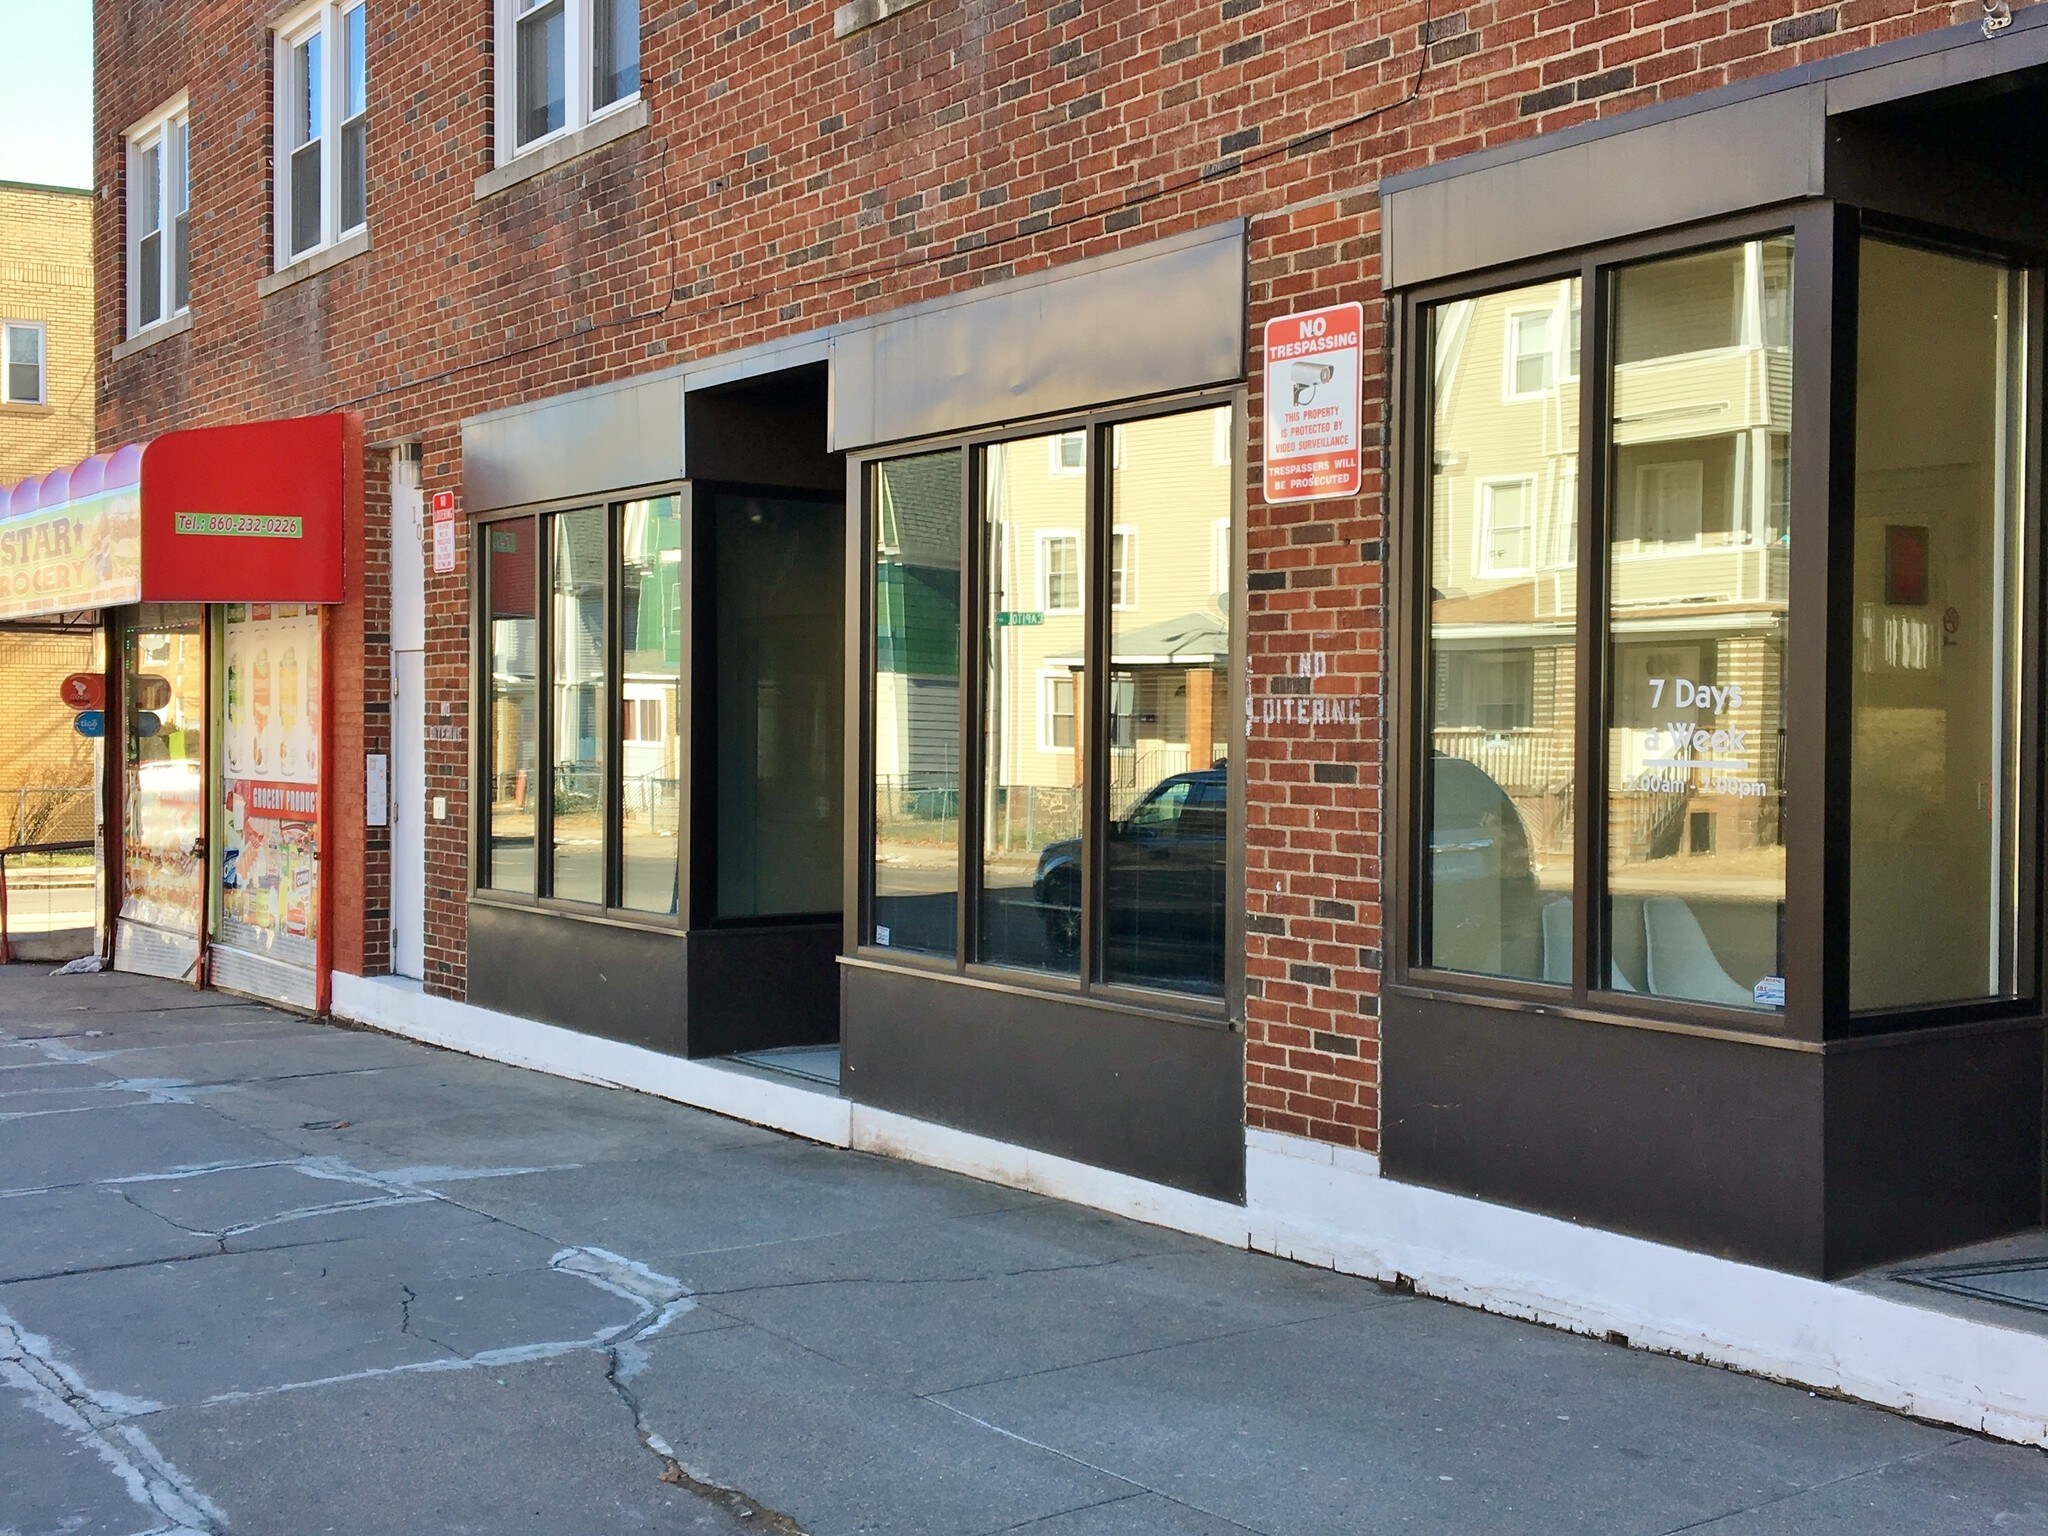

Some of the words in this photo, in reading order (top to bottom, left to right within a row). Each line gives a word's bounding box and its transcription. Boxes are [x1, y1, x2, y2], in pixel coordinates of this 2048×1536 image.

[1300, 317, 1326, 339] NO
[1270, 332, 1357, 359] TRESPASSING
[1285, 412, 1300, 423] THIS
[1303, 406, 1339, 420] PROPERTY
[1281, 428, 1288, 438] IS
[1291, 423, 1330, 437] PROTECTED
[1334, 421, 1343, 431] BY
[1276, 442, 1295, 453] VIDEO
[1299, 435, 1349, 450] SURVEILLANCE
[1269, 461, 1330, 477] TRESPASSERS
[1334, 458, 1356, 469] WILL
[1275, 481, 1286, 490] BE
[1291, 474, 1350, 489] PROSECUTED
[179, 515, 205, 529] Tel.:
[209, 517, 296, 533] 860-232-0226
[1, 517, 72, 567] STAR
[1299, 652, 1326, 677] NO
[1649, 680, 1665, 708] 7
[1676, 679, 1743, 715] Days
[1247, 697, 1360, 724] LOITERING
[1644, 728, 1659, 751] a
[1667, 723, 1746, 753] Week
[253, 788, 283, 810] GROCERY
